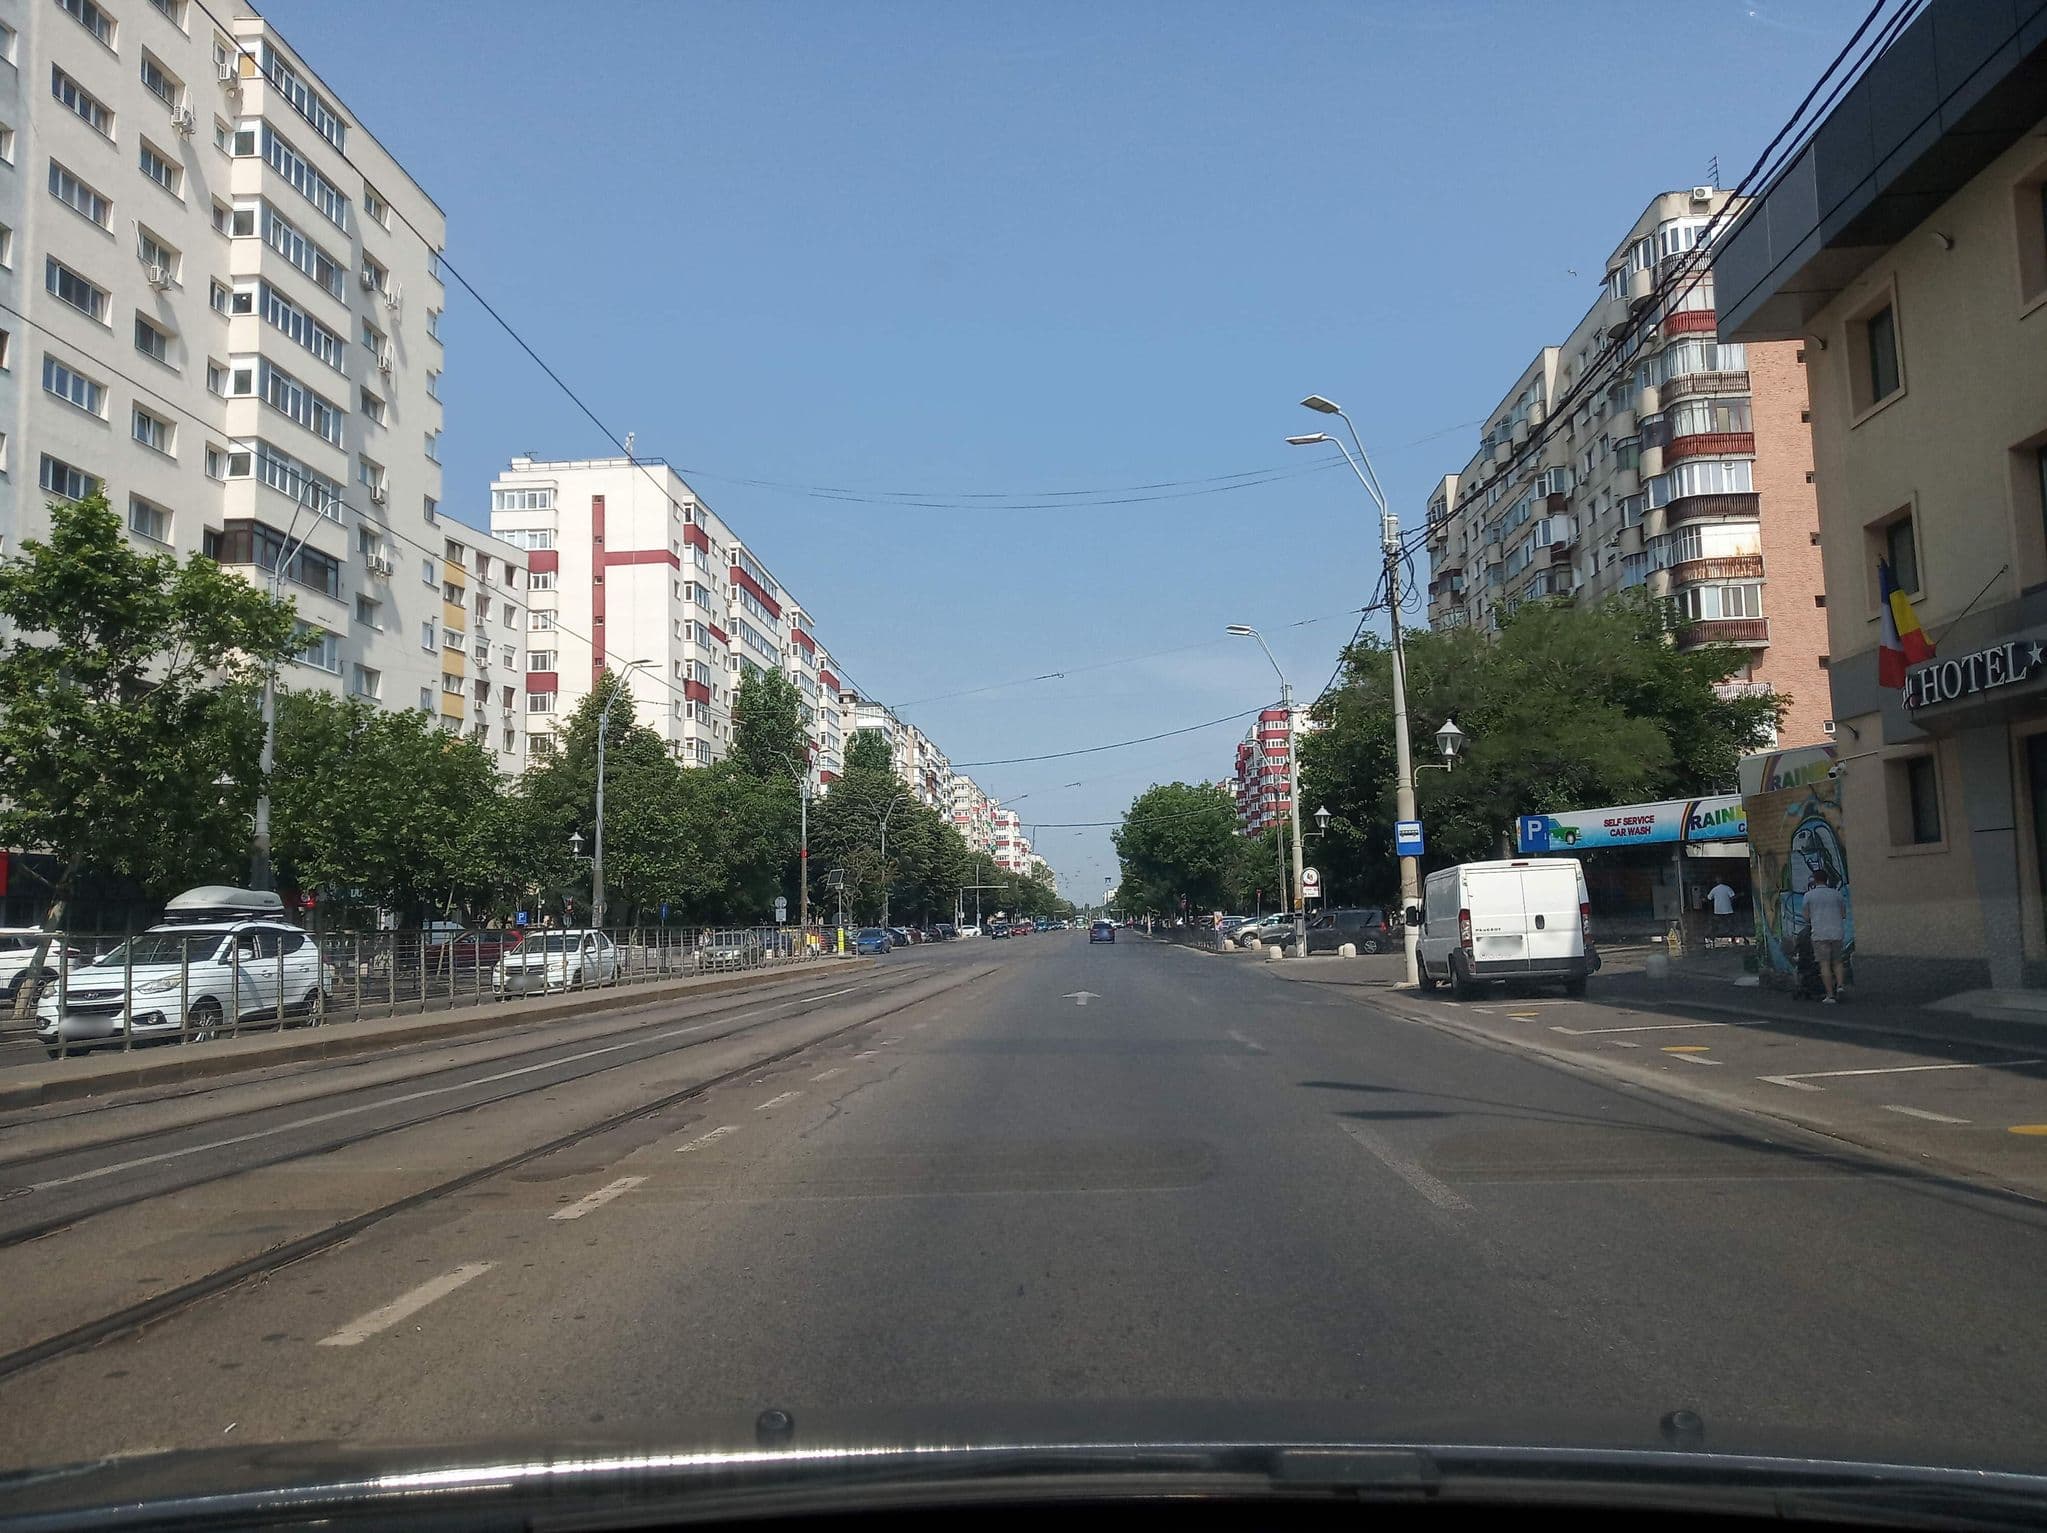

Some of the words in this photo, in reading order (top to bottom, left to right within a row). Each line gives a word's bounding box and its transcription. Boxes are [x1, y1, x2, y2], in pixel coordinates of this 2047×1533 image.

[1917, 642, 2027, 707] HOTEL
[1603, 817, 1622, 827] SELF
[1623, 814, 1655, 826] SERVICE
[1528, 820, 1542, 841] P
[1610, 828, 1626, 837] CAR
[1627, 825, 1651, 836] WASH
